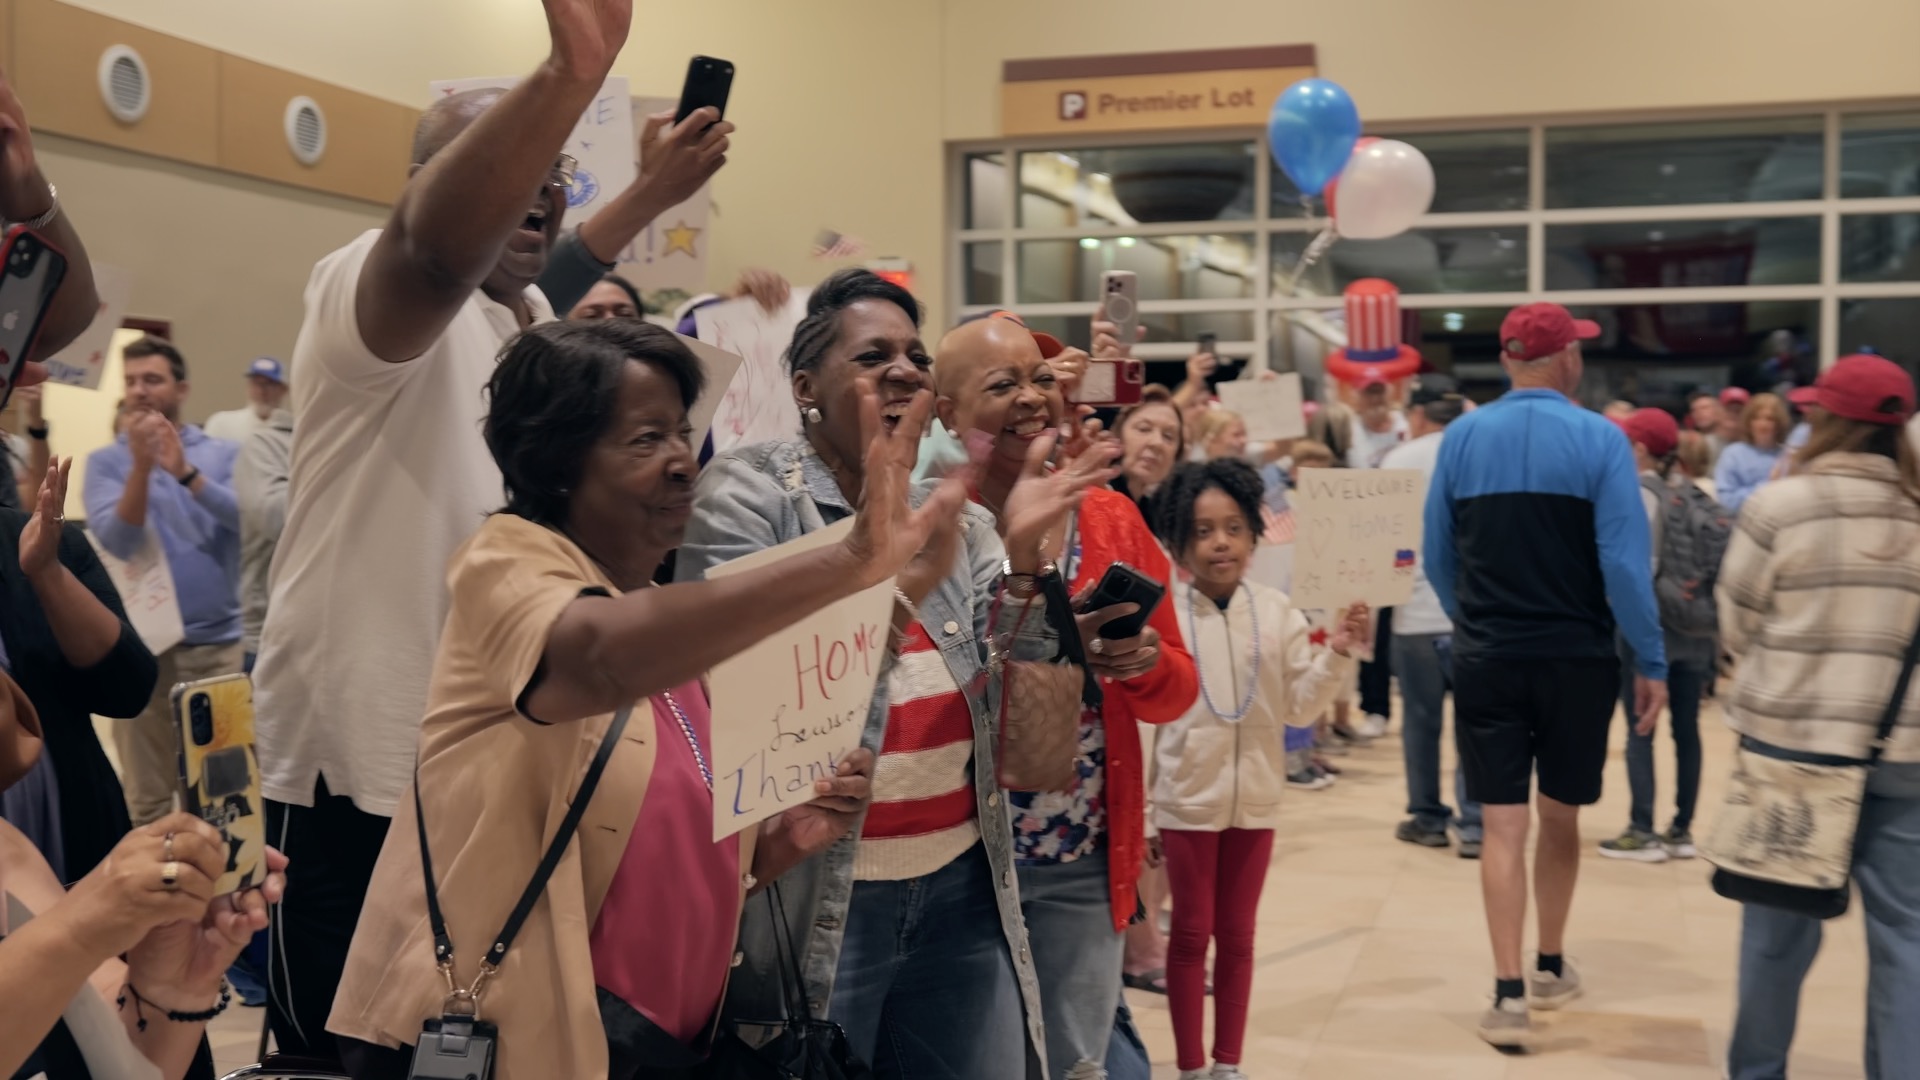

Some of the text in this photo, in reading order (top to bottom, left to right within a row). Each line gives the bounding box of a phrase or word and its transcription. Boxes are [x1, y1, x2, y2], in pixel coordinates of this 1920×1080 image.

[1061, 87, 1255, 119] P Premier Lot
[1305, 477, 1415, 501] WELCOME
